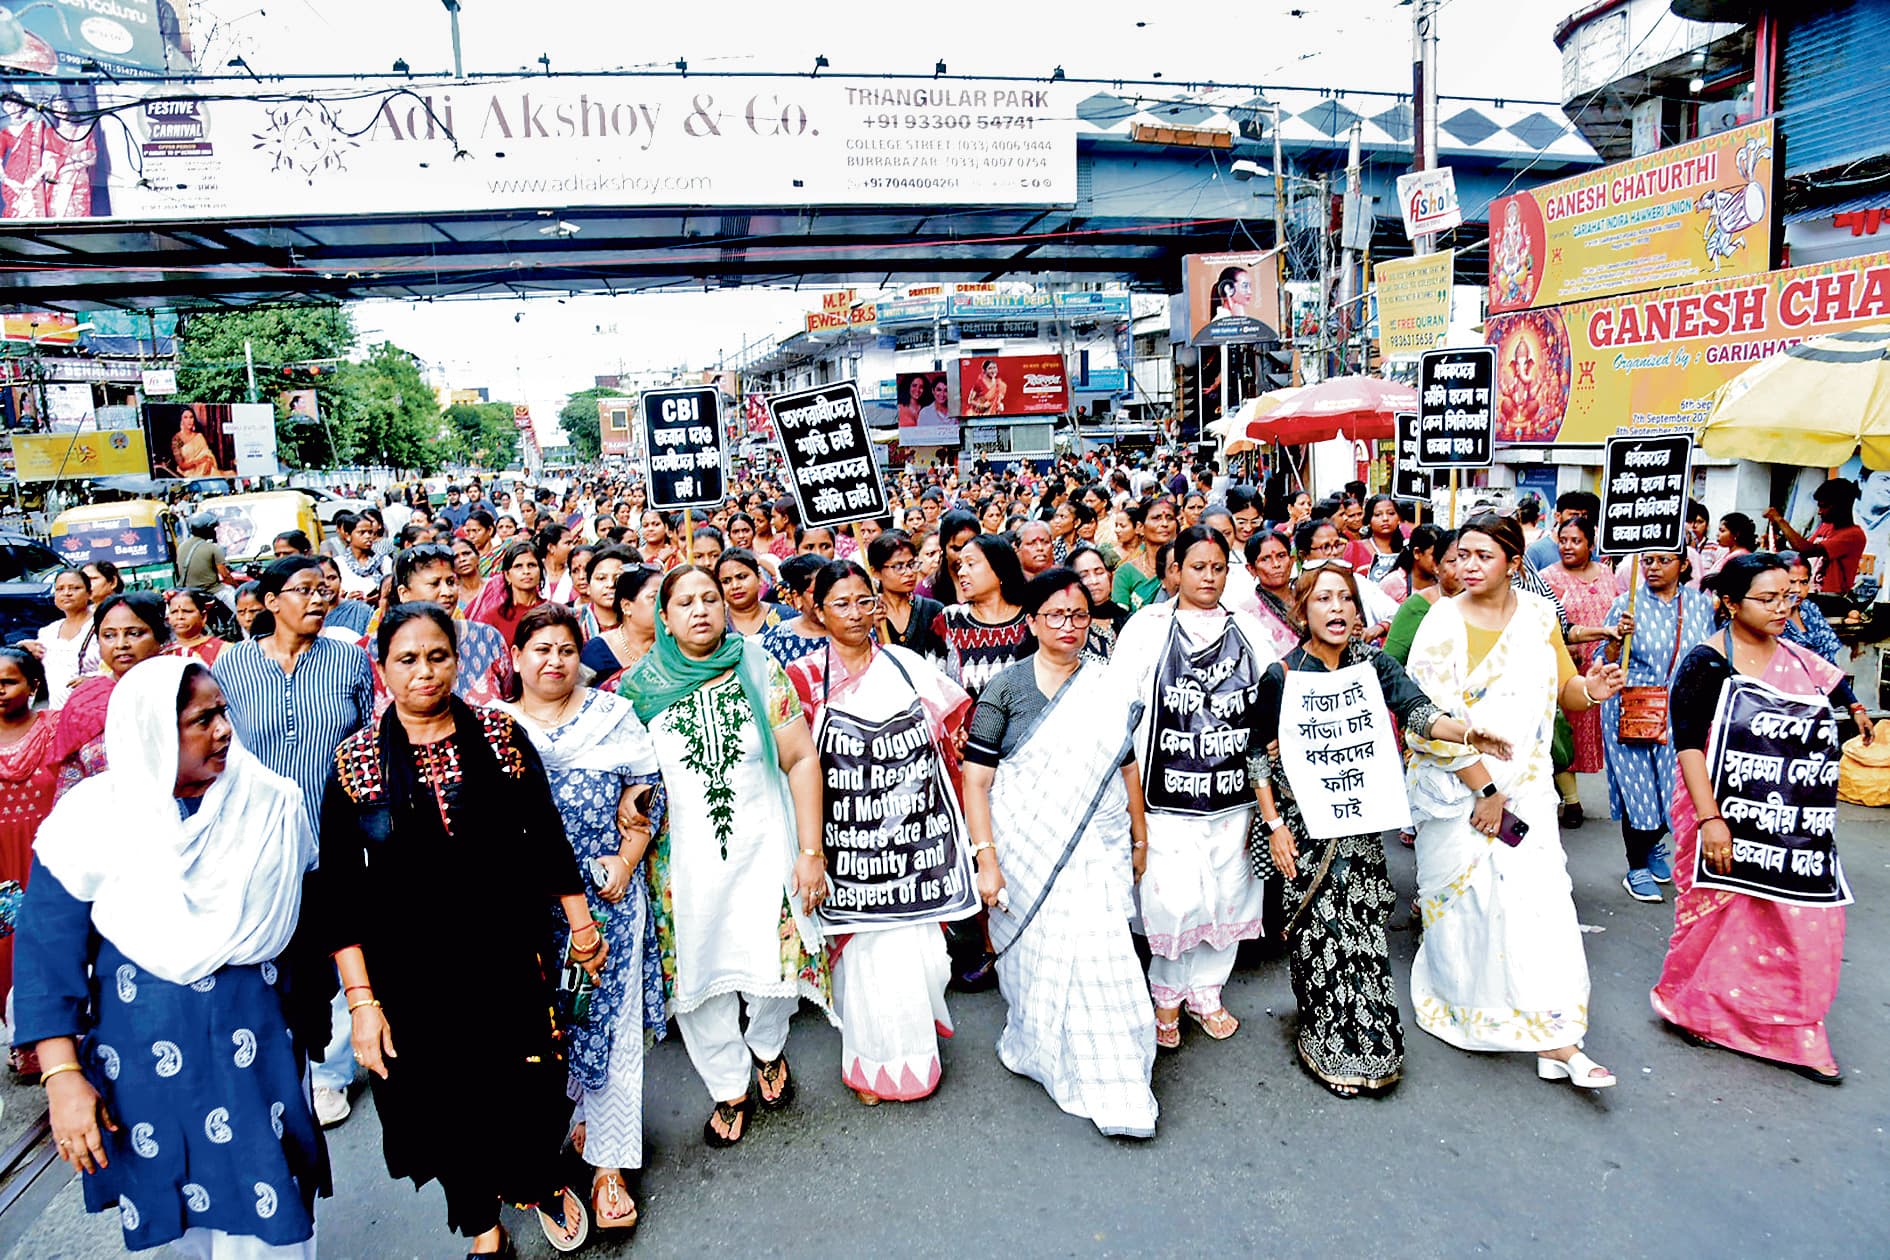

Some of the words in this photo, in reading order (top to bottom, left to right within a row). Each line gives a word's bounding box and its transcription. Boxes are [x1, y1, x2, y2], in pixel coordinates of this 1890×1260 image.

[148, 101, 194, 115] FESTIVE
[845, 87, 987, 107] TRIANGULAR
[993, 90, 1049, 108] PARK
[153, 124, 203, 138] CARNIVAL
[371, 95, 453, 141] Adi
[480, 93, 661, 150] Akshoy
[683, 93, 723, 137] &
[745, 94, 819, 137] Co.
[904, 114, 971, 129] 93300
[976, 115, 1034, 130] 54741
[846, 138, 902, 150] COLLEGE
[487, 174, 712, 194] www.adiakshoy.com
[1546, 184, 1607, 221] GANESH
[1611, 153, 1717, 205] CHATURTHI
[1573, 219, 1606, 237] GARIAHAT
[1606, 214, 1629, 231] INDIRA
[1666, 199, 1692, 217] UNION
[908, 286, 941, 297] DENTITY
[956, 284, 992, 292] DENTAL
[973, 295, 1021, 305] DENTITY
[807, 304, 876, 332] JEWELLERS
[1588, 287, 1767, 348] GANESH
[1779, 268, 1890, 327] CHA
[1003, 322, 1036, 332] DENTAL
[1433, 356, 1476, 380] ধর্ষকদের
[1613, 350, 1671, 373] Organised
[1674, 348, 1690, 368] by
[1424, 384, 1447, 406] ফাঁসি
[1448, 388, 1474, 405] হলো
[1475, 388, 1488, 405] না
[1680, 400, 1695, 411] 6th
[661, 397, 699, 422] CBI
[779, 394, 855, 428] অপরাধীদের
[1422, 415, 1443, 431] কেন
[1444, 409, 1488, 431] সিবিআই
[1632, 413, 1645, 425] 7th
[1646, 413, 1690, 425] September
[653, 428, 687, 446] জবাব
[688, 426, 713, 445] দাও
[795, 428, 829, 456] শাস্তি
[828, 423, 854, 451] চাই
[1616, 426, 1628, 436] 8th
[1629, 426, 1672, 436] September
[1426, 438, 1452, 454] জবাব
[1453, 438, 1474, 454] দাও
[1625, 443, 1671, 467] ধর্ষকদের
[796, 455, 870, 487] ধর্ষকদের
[1612, 472, 1639, 494] ফাঁসি
[1641, 475, 1666, 493] হলো
[1667, 474, 1682, 490] না
[812, 487, 846, 514] ফাঁসি
[1608, 503, 1634, 519] কেন
[1635, 495, 1680, 519] সিবিআই
[1612, 525, 1641, 541] জবাব
[1642, 523, 1662, 539] দাও
[1163, 677, 1206, 715] ফাঁসি
[1246, 683, 1259, 704] ন
[1302, 688, 1340, 712] সাঁজা
[1342, 682, 1367, 706] চাই
[1298, 716, 1343, 739] সাঁজা
[1346, 709, 1374, 733] চাই
[1751, 711, 1814, 744] দেশে
[826, 726, 865, 756] The
[872, 719, 931, 760] Dignit
[1160, 727, 1196, 759] কেন
[1305, 741, 1374, 765] ধর্ষকদের
[828, 765, 864, 791] and
[1164, 768, 1212, 798] জবাব
[1216, 769, 1244, 795] দাও
[1321, 768, 1365, 792] ফাঁসি
[1724, 749, 1784, 792] সুরক্ষা
[1788, 751, 1824, 787] নেই
[1820, 760, 1839, 787] কে
[833, 796, 850, 821] of
[855, 789, 926, 822] Mothers
[1331, 798, 1362, 818] চাই
[1721, 791, 1799, 835] কেন্দ্রীয়
[826, 821, 889, 849] Sisters
[894, 820, 921, 845] are
[925, 813, 950, 840] the
[836, 850, 907, 880] Dignity
[912, 838, 945, 871] and
[1732, 837, 1787, 873] জবাব
[1790, 849, 1825, 877] দাও
[899, 878, 918, 903] of
[921, 878, 940, 900] us
[943, 867, 963, 896] all
